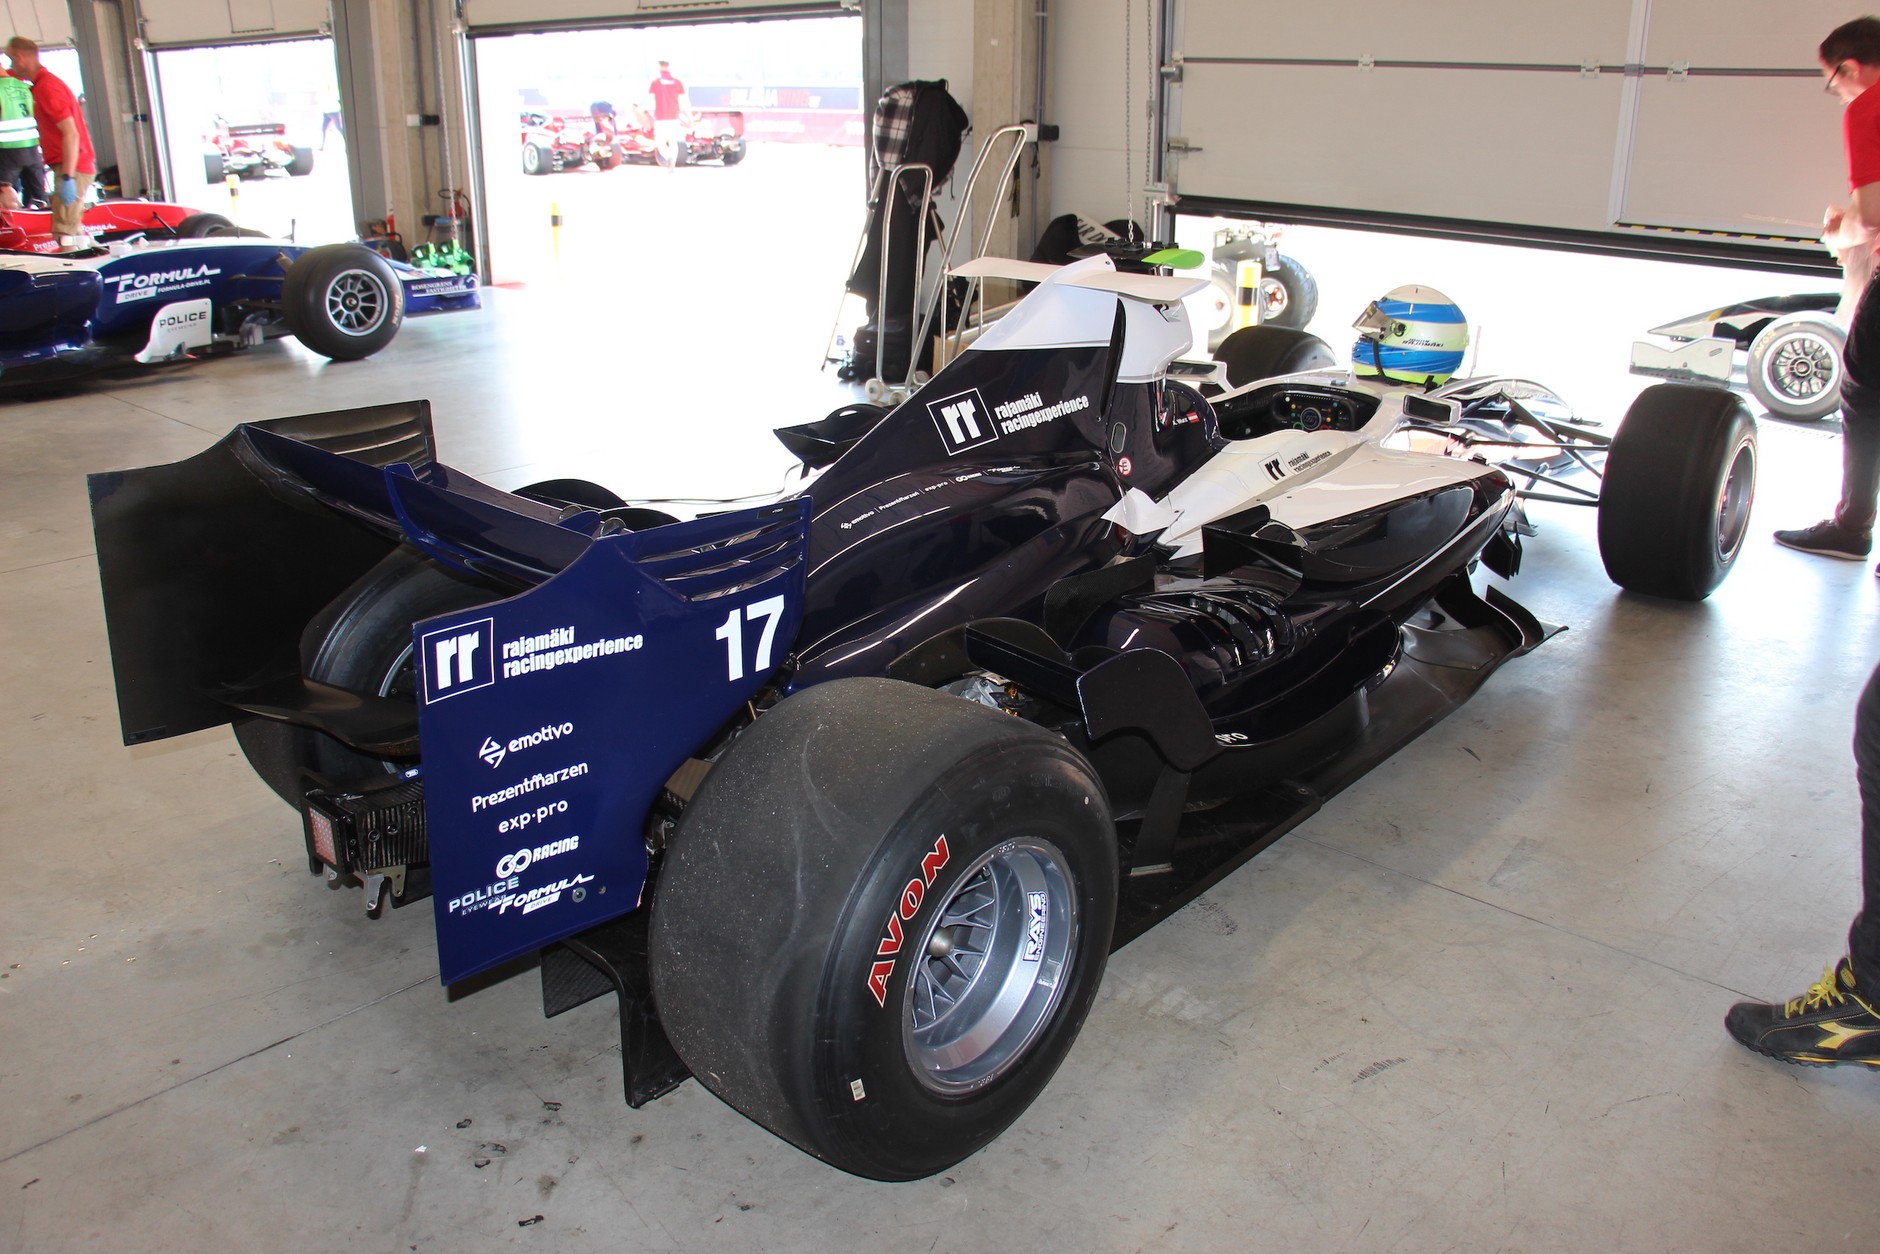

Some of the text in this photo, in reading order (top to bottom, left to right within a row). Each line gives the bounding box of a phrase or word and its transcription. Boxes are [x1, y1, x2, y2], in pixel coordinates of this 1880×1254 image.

[104, 264, 221, 292] FORMULA
[125, 290, 149, 300] DRIVE
[160, 311, 207, 328] POLICE
[941, 392, 1043, 444] rr rajamäki
[1000, 395, 1090, 435] racingexperience
[1264, 451, 1310, 481] rr rajamäki
[503, 634, 643, 679] racingexperience
[715, 594, 785, 682] 17
[435, 626, 575, 691] rr rajamäki
[508, 722, 574, 753] emotivo
[449, 876, 520, 914] POLICE
[488, 873, 595, 915] FORMULA
[530, 897, 552, 909] DRIVE
[867, 833, 950, 1008] AVON
[1023, 893, 1042, 961] RAYS
